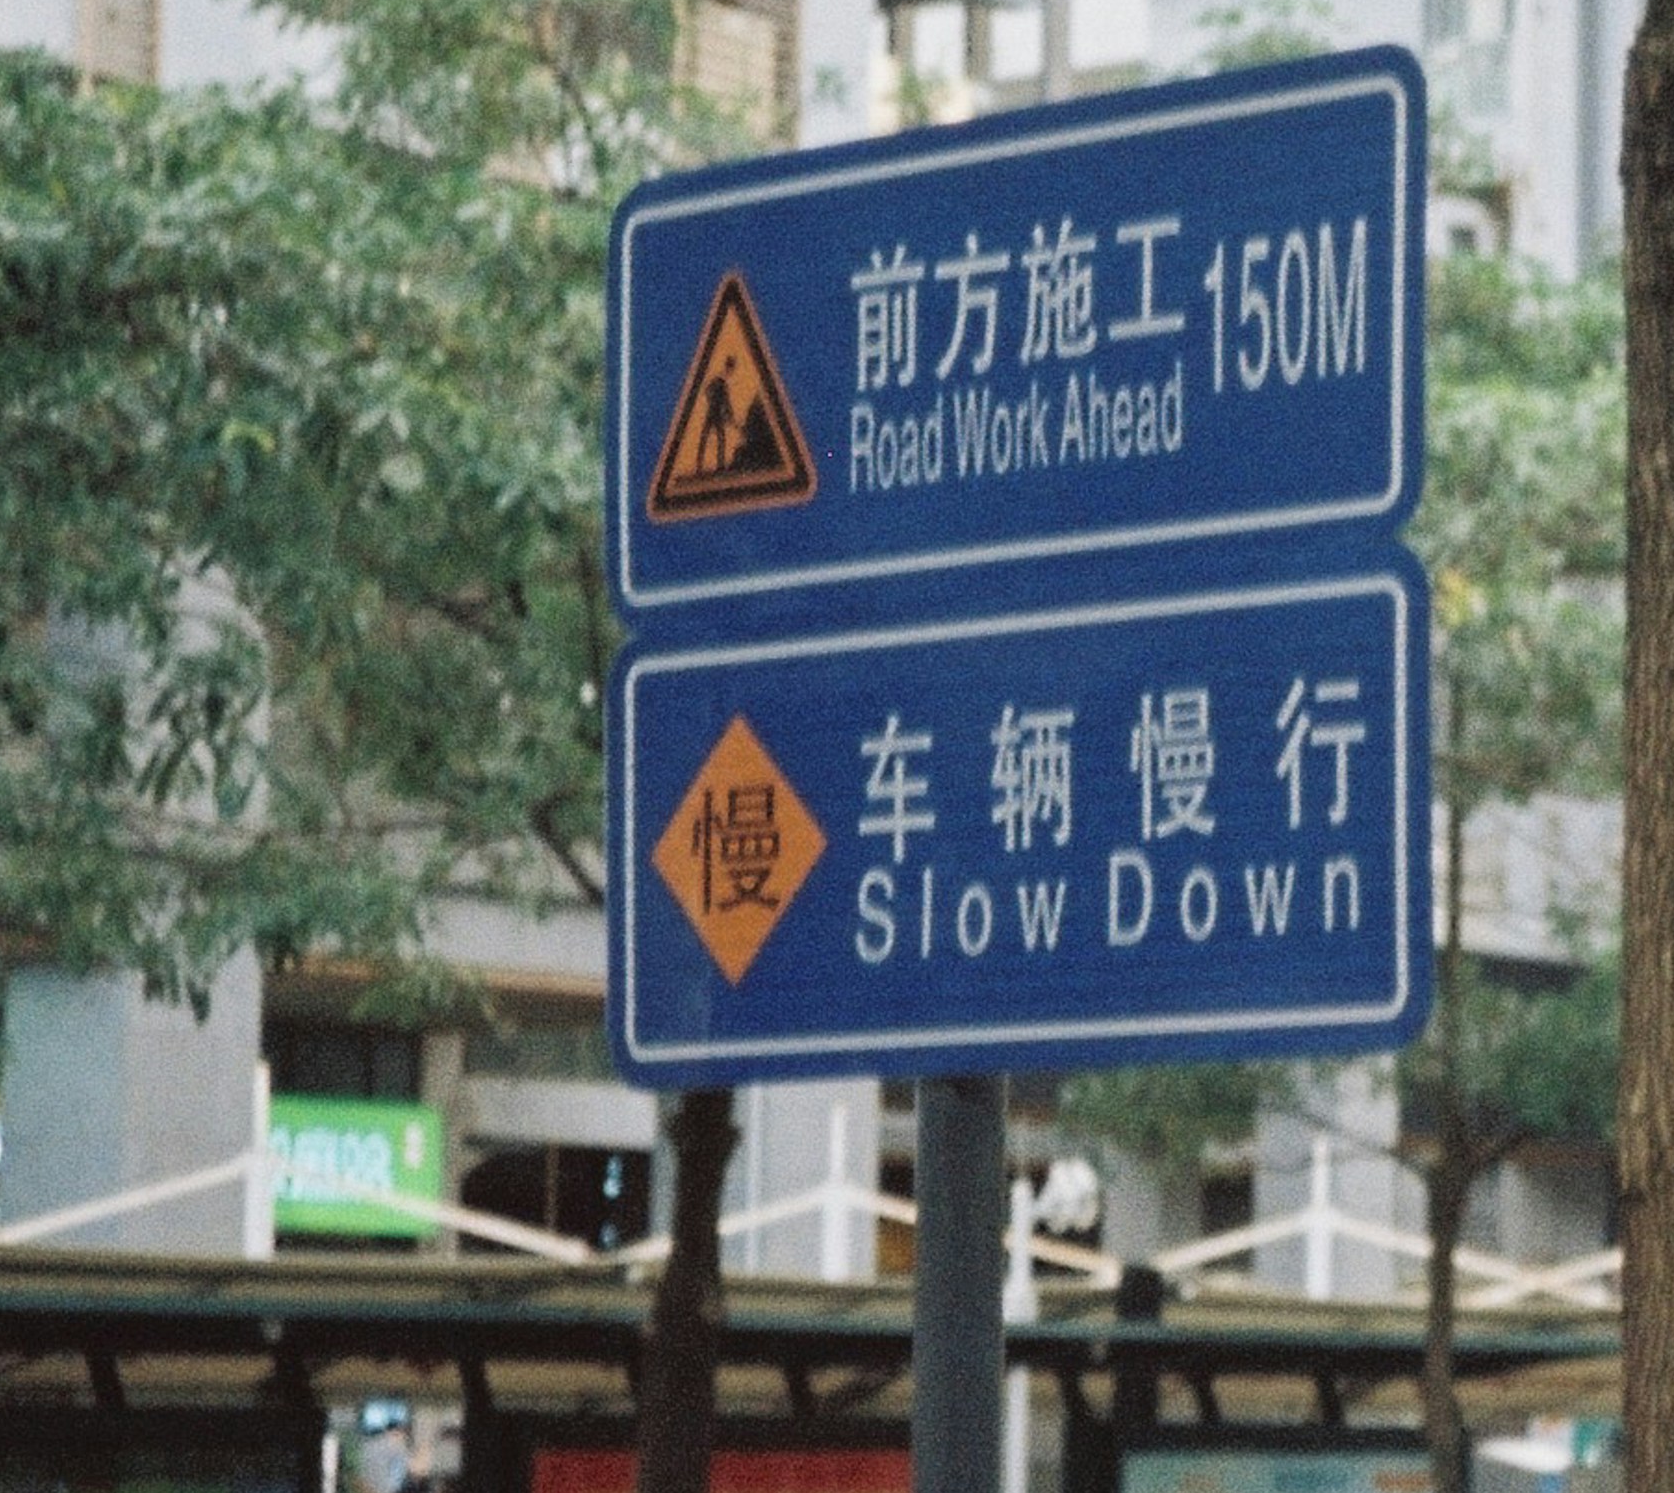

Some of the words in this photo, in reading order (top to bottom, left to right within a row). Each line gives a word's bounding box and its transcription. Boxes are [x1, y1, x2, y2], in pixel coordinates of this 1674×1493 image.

[849, 216, 1186, 392] 前方施工
[1203, 217, 1368, 392] 150M
[849, 384, 944, 494] Road
[953, 384, 1049, 479] Work
[1059, 362, 1184, 463] Ahead
[857, 677, 1366, 863] 车辆慢行
[690, 783, 784, 915] 慢
[855, 867, 1068, 964] Slow
[1107, 848, 1362, 947] Down
